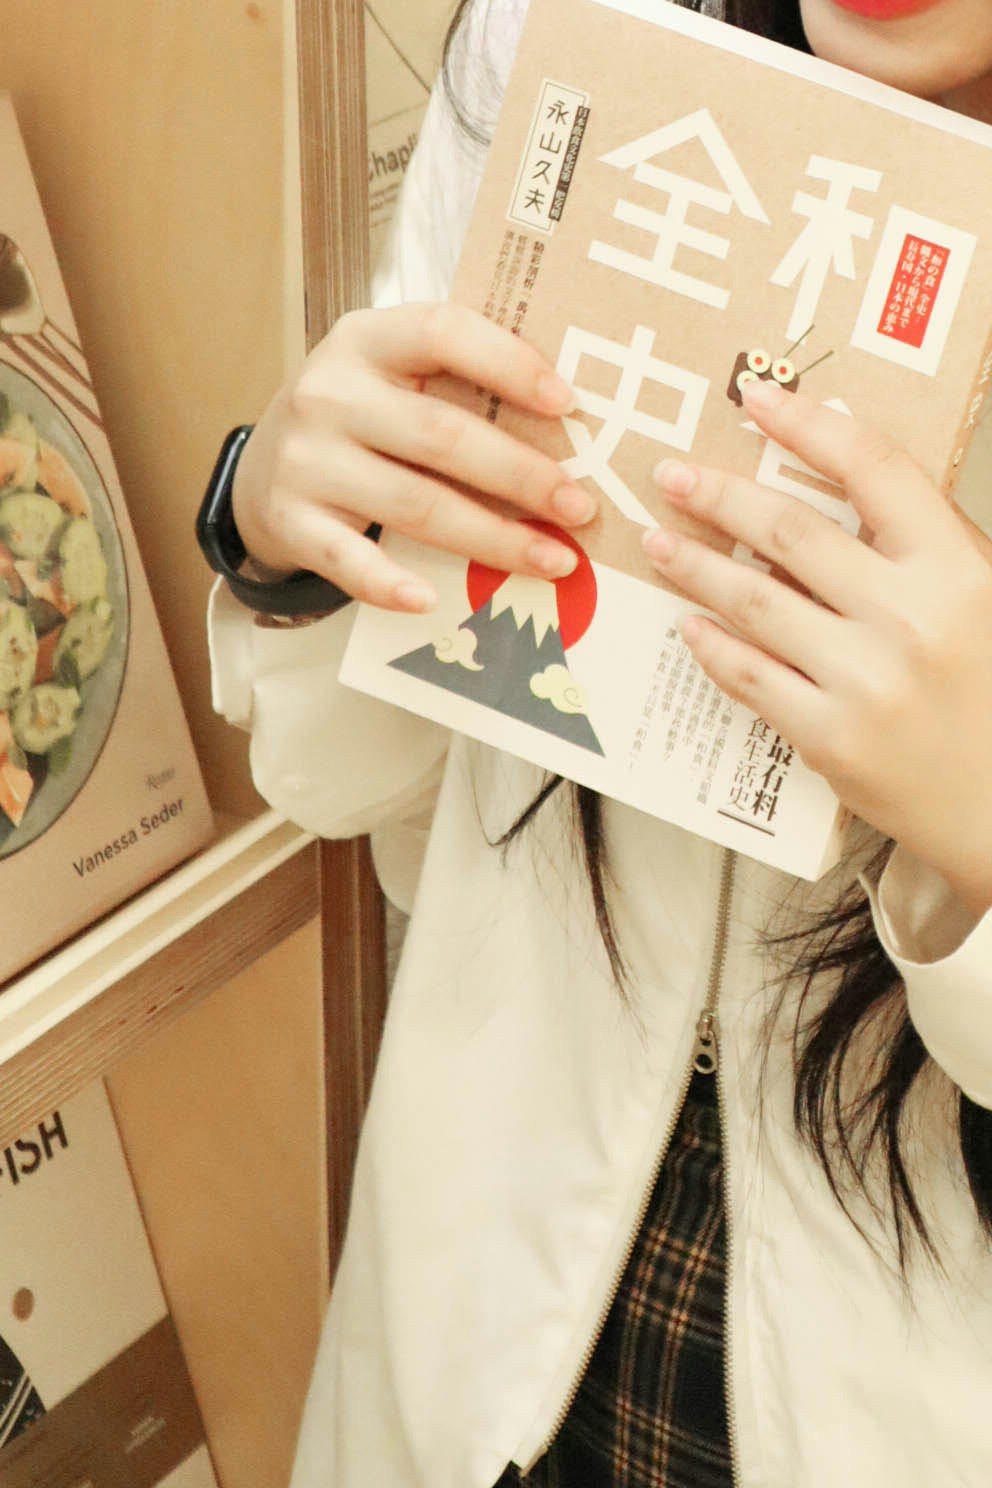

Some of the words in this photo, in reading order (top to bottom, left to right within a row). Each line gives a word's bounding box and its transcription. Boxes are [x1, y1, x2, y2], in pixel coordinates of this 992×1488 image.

[523, 99, 571, 214] 永山久夫
[72, 829, 138, 878] Vanessa
[140, 798, 184, 837] Seder
[0, 1110, 68, 1185] ISH
